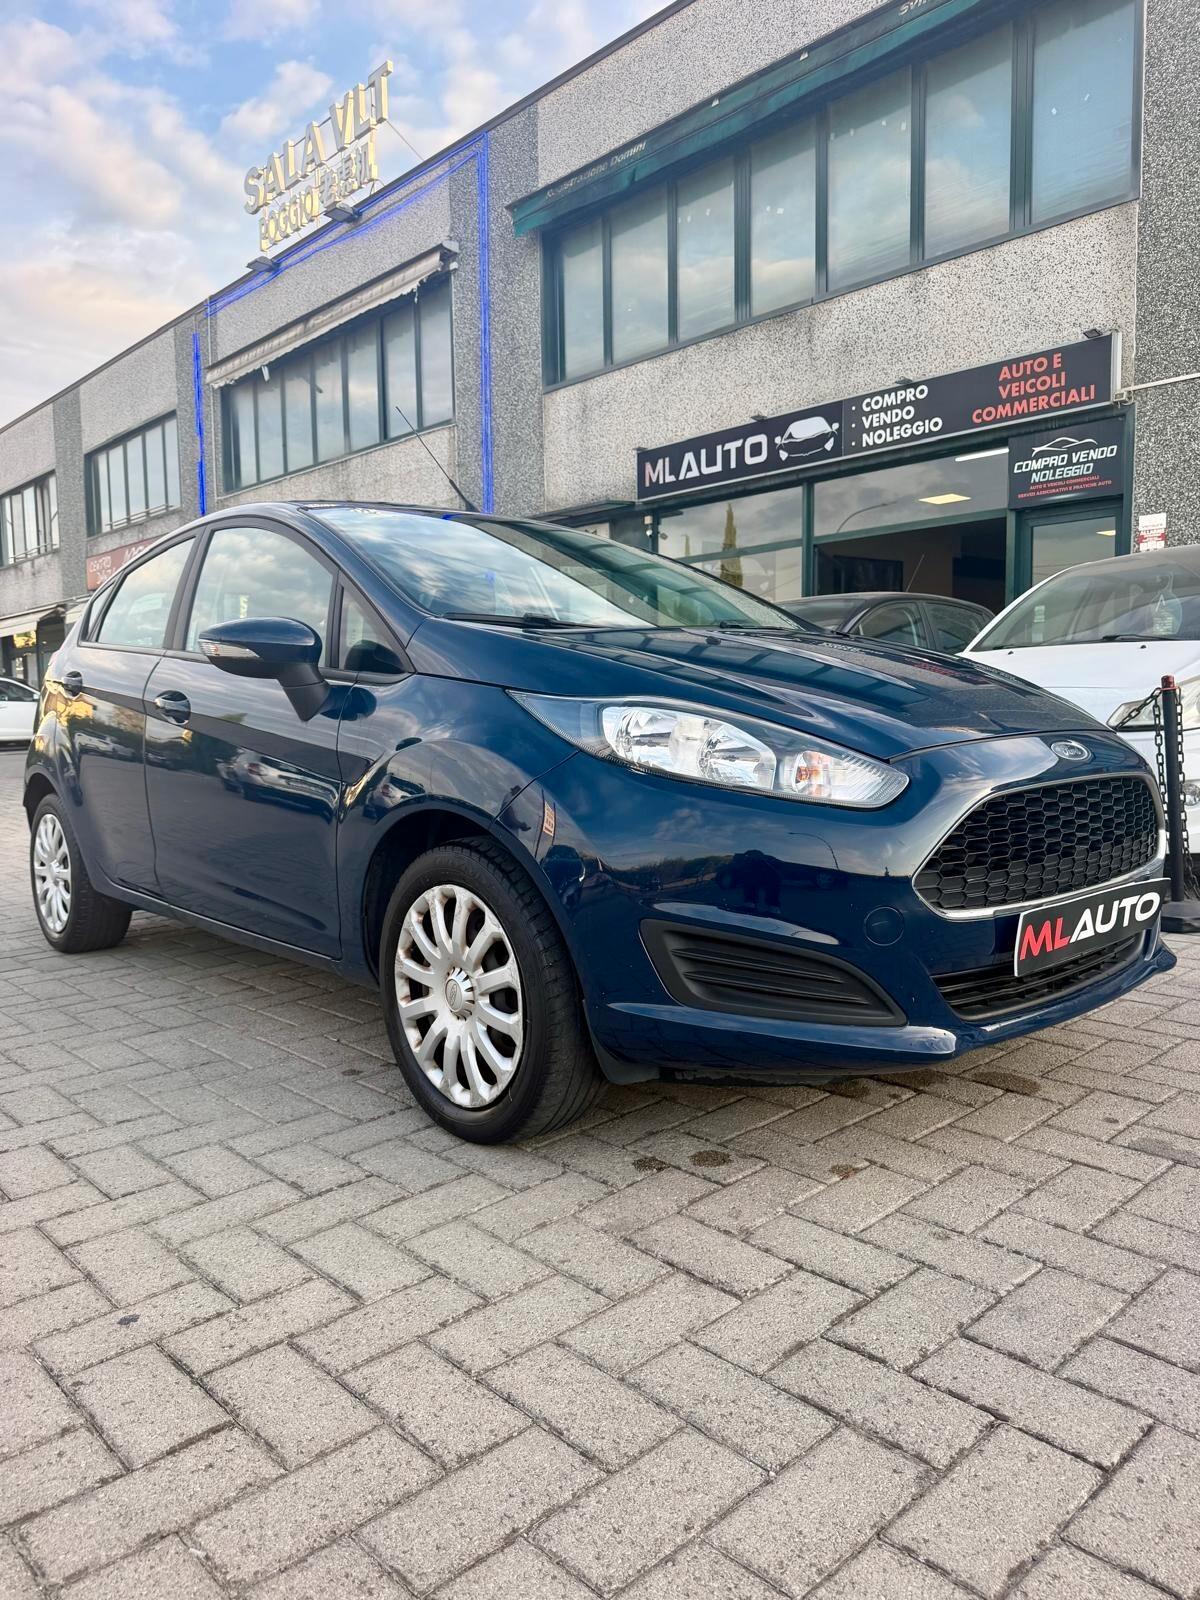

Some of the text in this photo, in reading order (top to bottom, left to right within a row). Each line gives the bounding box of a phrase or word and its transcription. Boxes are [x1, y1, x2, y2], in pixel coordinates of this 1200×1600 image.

[244, 121, 325, 215] SALA
[329, 59, 393, 151] VLT
[259, 185, 319, 251] POGGIO
[998, 352, 1062, 381] AUTO E
[862, 384, 929, 412] COMPRO
[998, 371, 1066, 399] VEICOLI
[862, 405, 915, 429] VENDO
[972, 384, 1096, 424] COMMERCIALI
[862, 417, 943, 447] NOLEGGIO
[1013, 445, 1118, 474] COMPRO VENDO
[1030, 463, 1094, 483] NOLEGGIO
[1029, 482, 1042, 490] AUTO
[1098, 479, 1113, 487] AUTO
